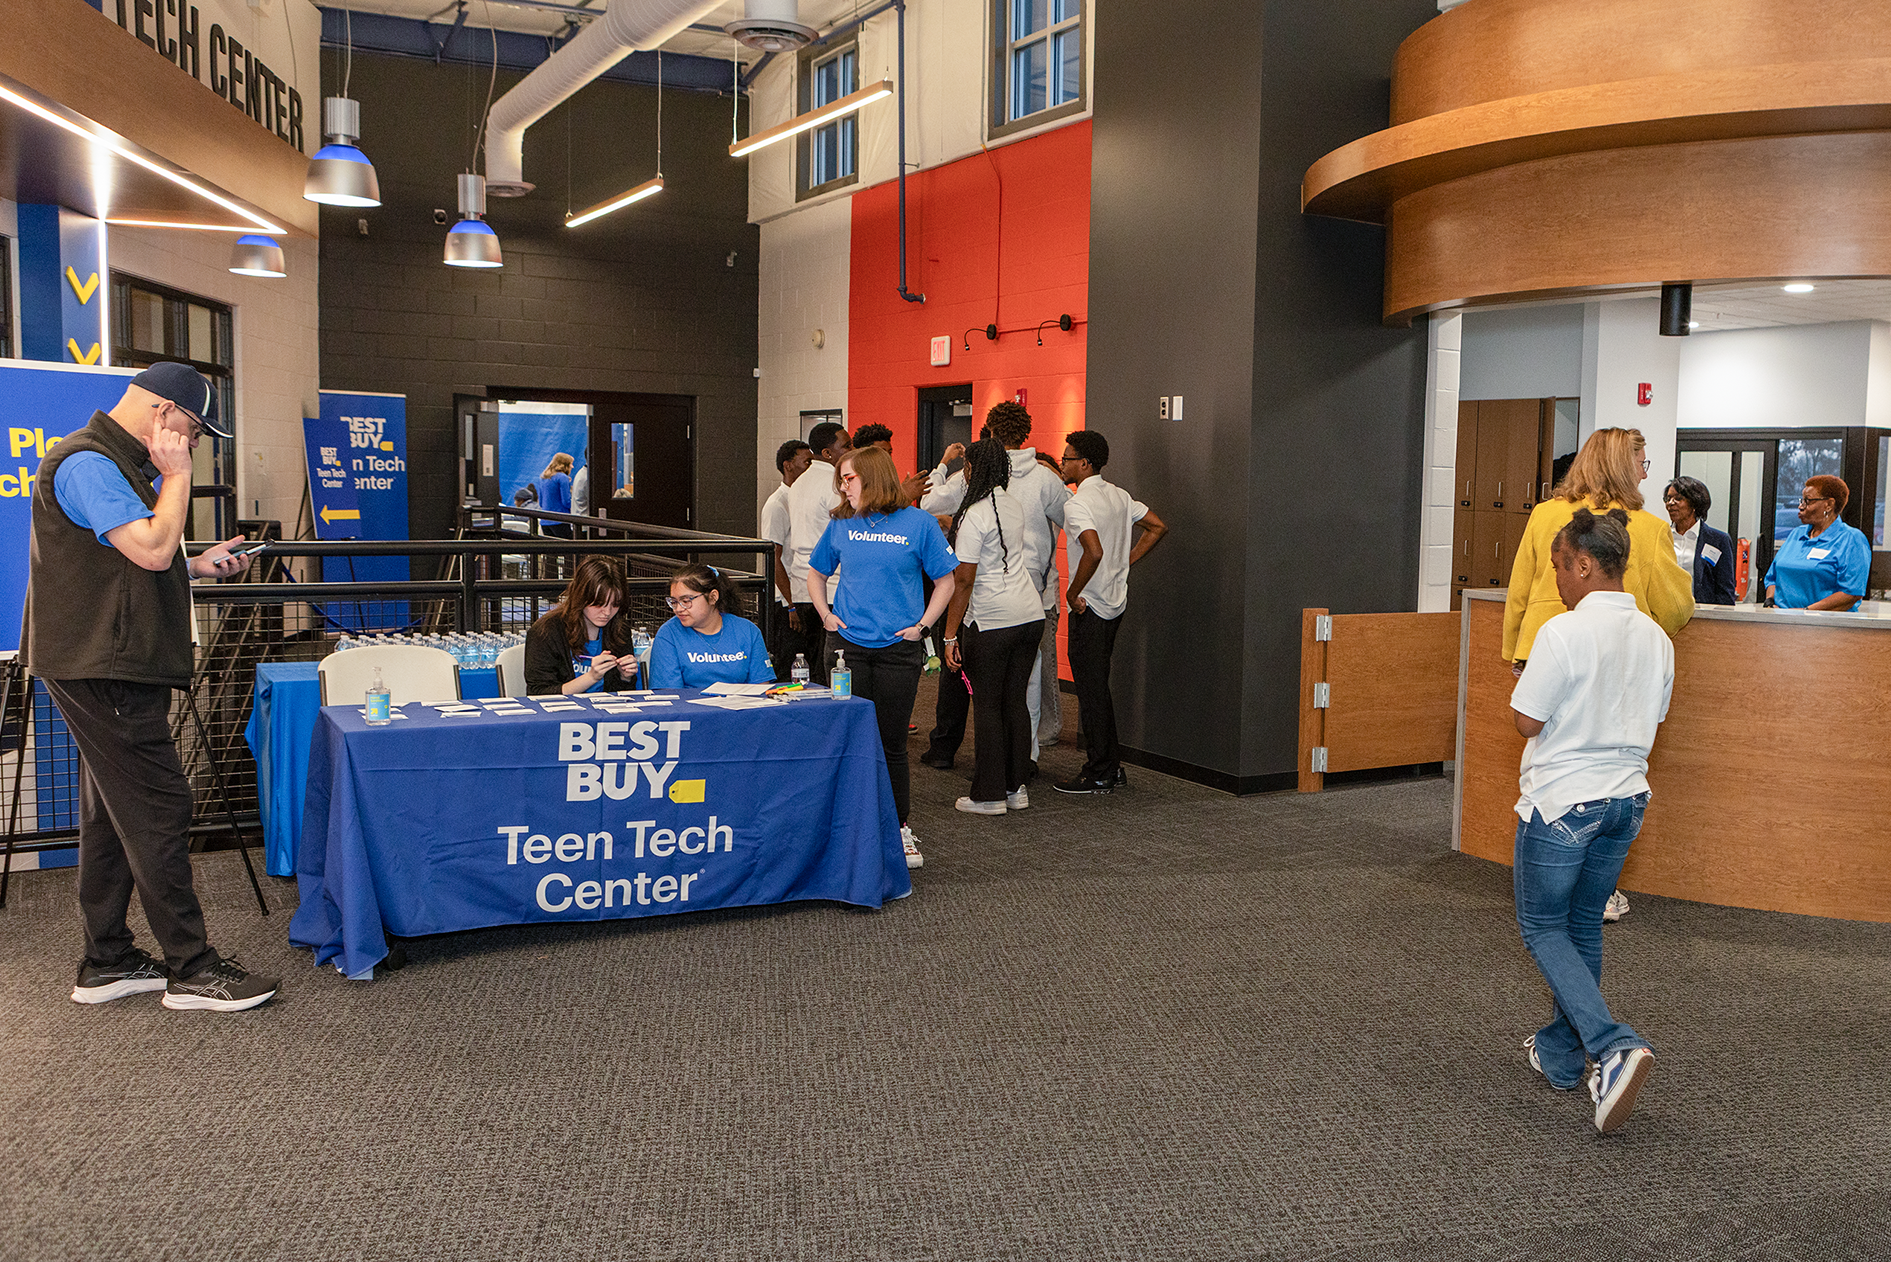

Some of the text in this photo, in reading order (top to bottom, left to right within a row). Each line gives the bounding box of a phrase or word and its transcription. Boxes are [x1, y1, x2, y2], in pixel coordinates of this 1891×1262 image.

[209, 23, 304, 156] CENTER
[932, 340, 946, 362] EXIT
[316, 467, 347, 478] Teen Tech
[365, 455, 405, 471] Tech
[322, 478, 343, 488] Center
[354, 475, 394, 490] enter
[848, 530, 909, 546] Volunteer.
[558, 720, 691, 761] BEST
[566, 760, 679, 802] BUY
[497, 816, 734, 865] Teen Tech
